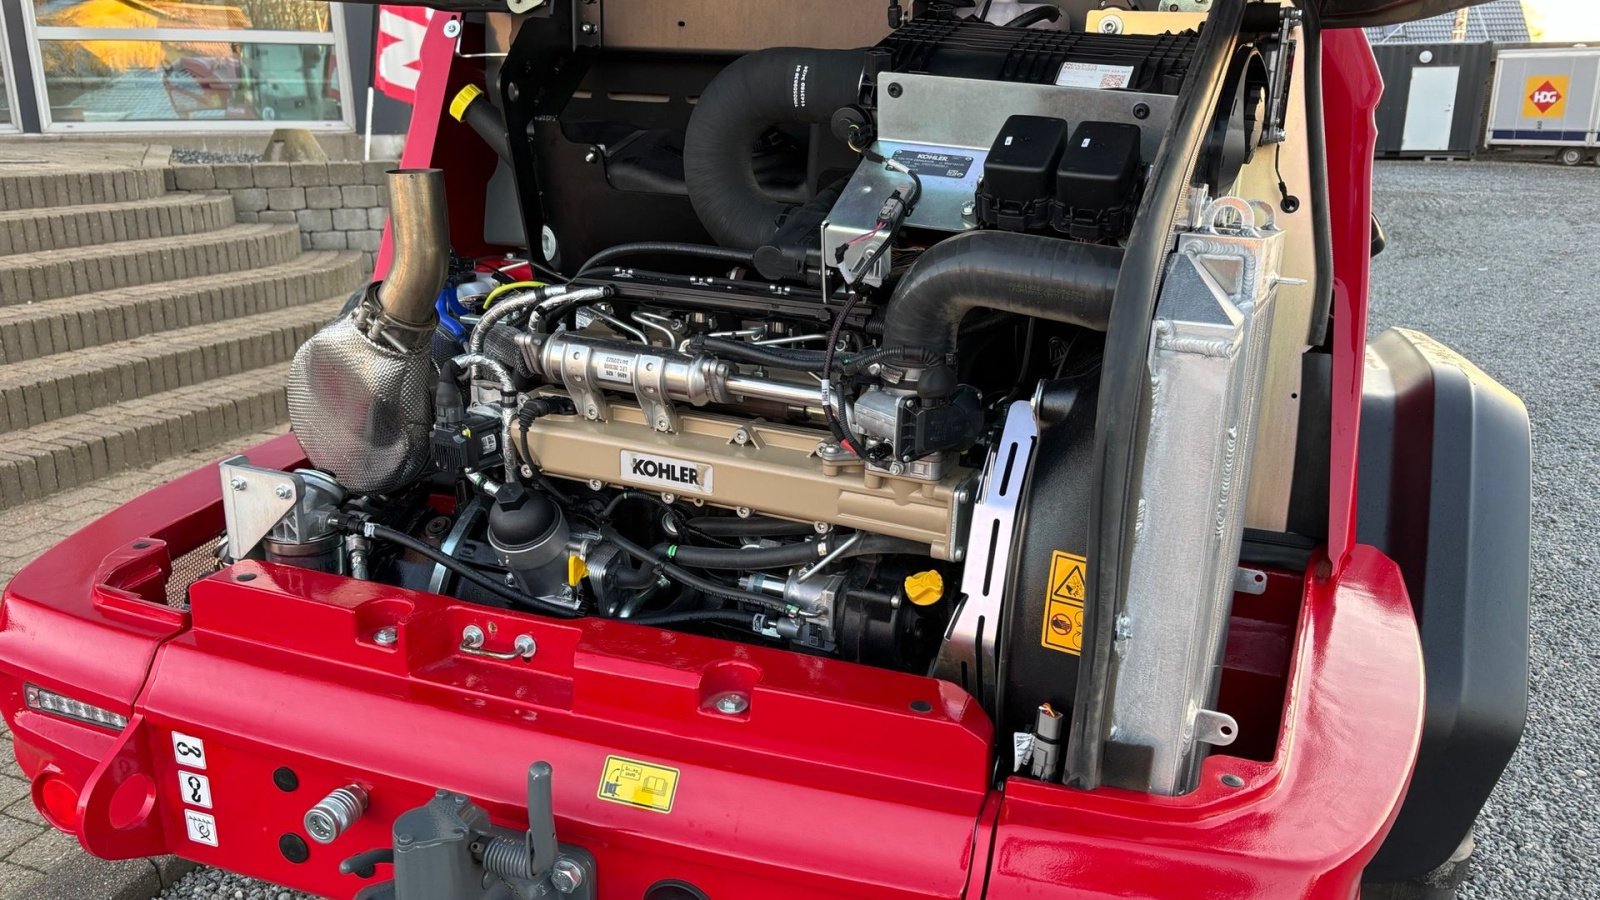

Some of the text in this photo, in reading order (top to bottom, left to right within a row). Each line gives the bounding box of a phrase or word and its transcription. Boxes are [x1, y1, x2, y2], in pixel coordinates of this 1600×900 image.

[1533, 90, 1557, 103] HDG
[917, 153, 949, 162] KOHLER
[632, 457, 700, 486] KOHLER
